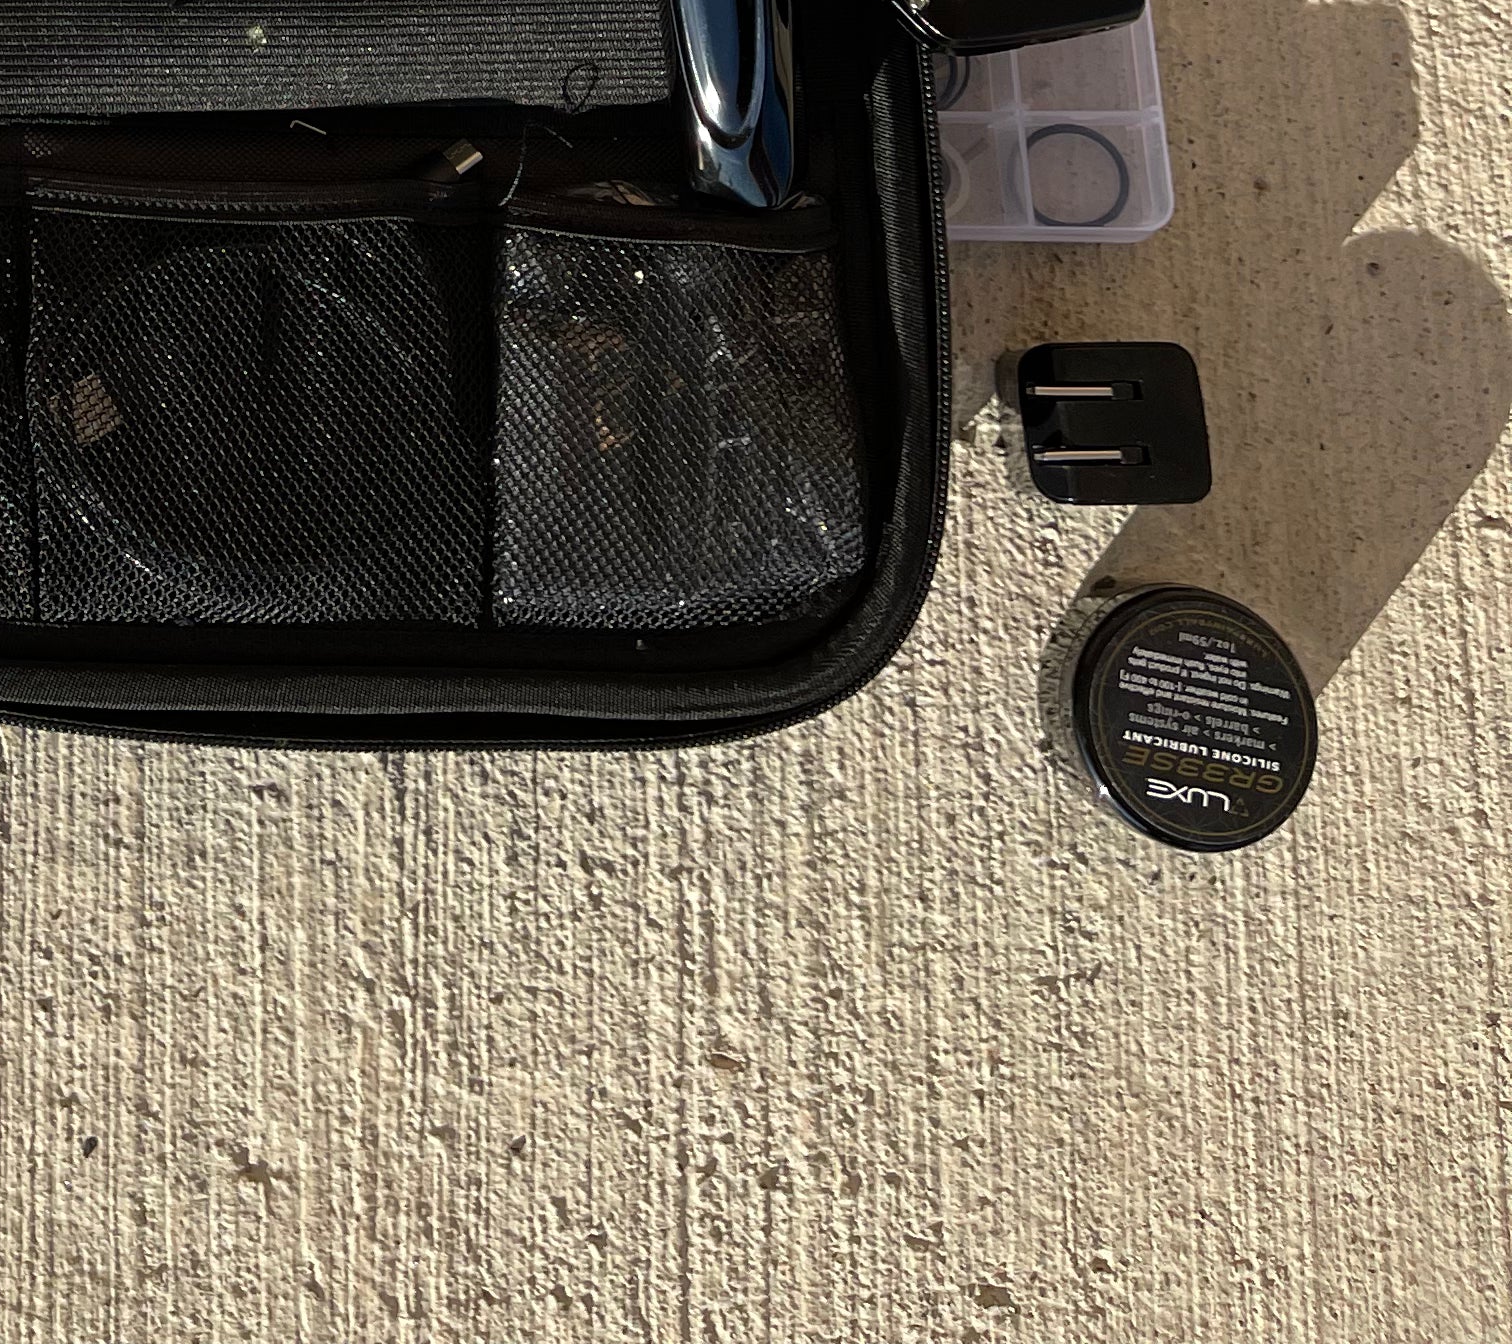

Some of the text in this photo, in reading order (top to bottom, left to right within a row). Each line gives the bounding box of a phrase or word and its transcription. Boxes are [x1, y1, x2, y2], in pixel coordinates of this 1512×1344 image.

[1127, 711, 1264, 749] markers air systems
[1204, 714, 1248, 735] barrels
[1120, 743, 1282, 792] GR33SE
[1121, 728, 1279, 771] SILICONE LUBRICANT
[1145, 777, 1229, 811] LUXE
